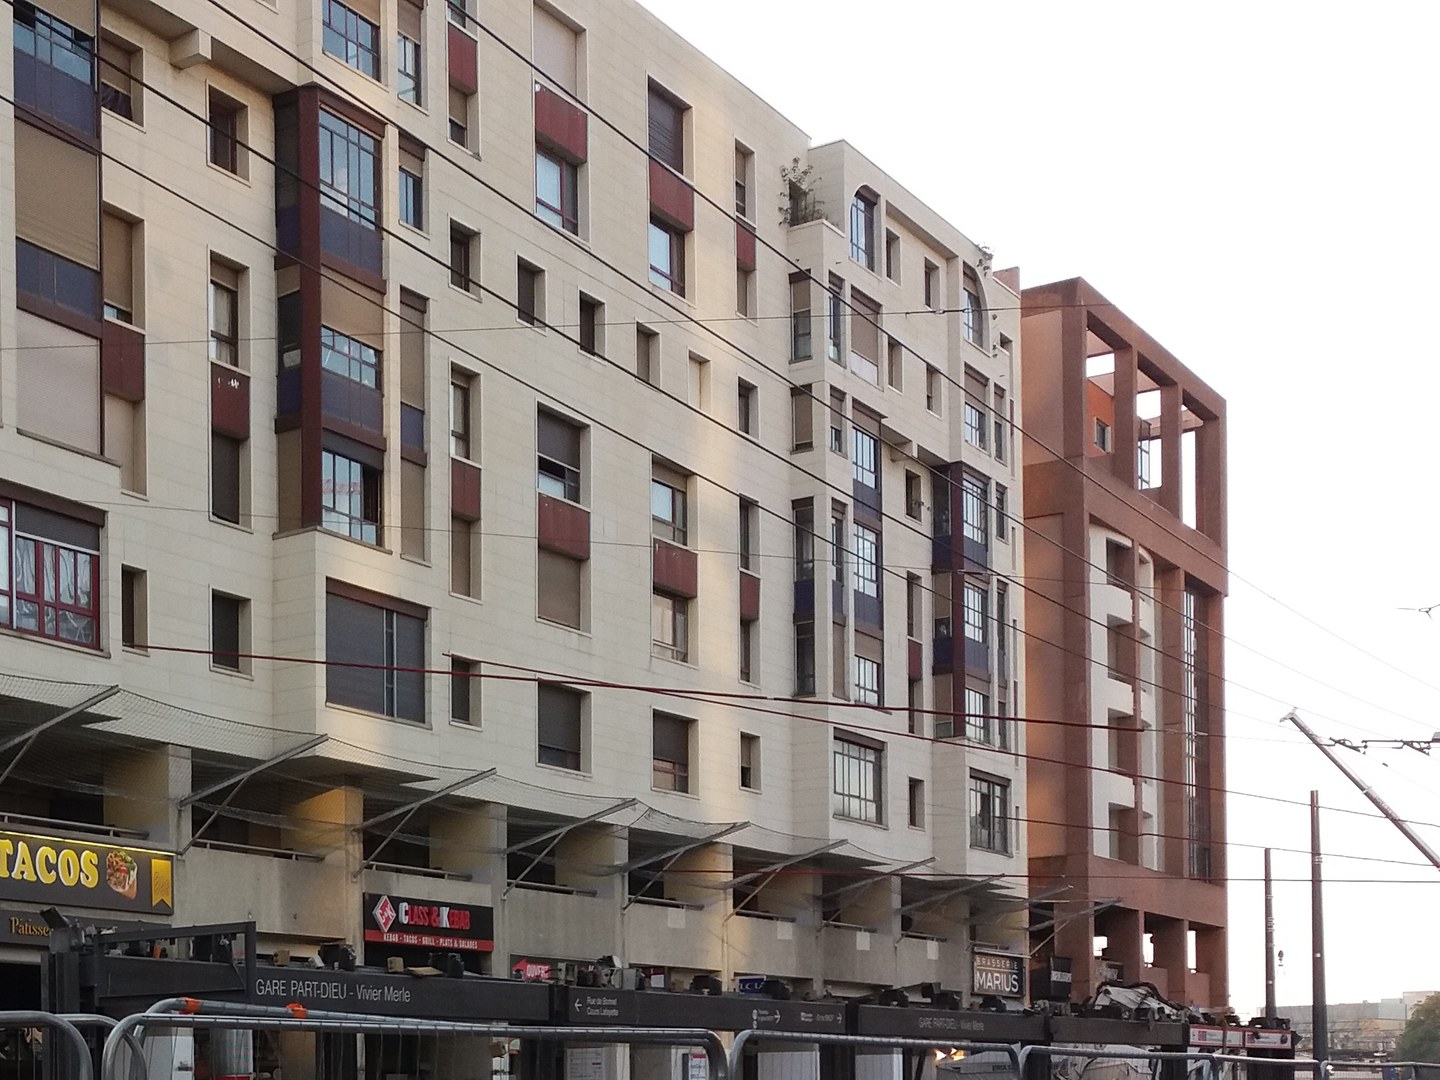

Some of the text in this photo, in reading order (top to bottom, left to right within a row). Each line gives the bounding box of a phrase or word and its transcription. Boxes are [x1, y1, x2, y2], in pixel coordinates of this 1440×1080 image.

[976, 956, 1018, 970] BRASSERIE
[255, 978, 411, 1002] GARE PART-DIEU Vivier Merle
[975, 971, 1019, 993] MARIUS
